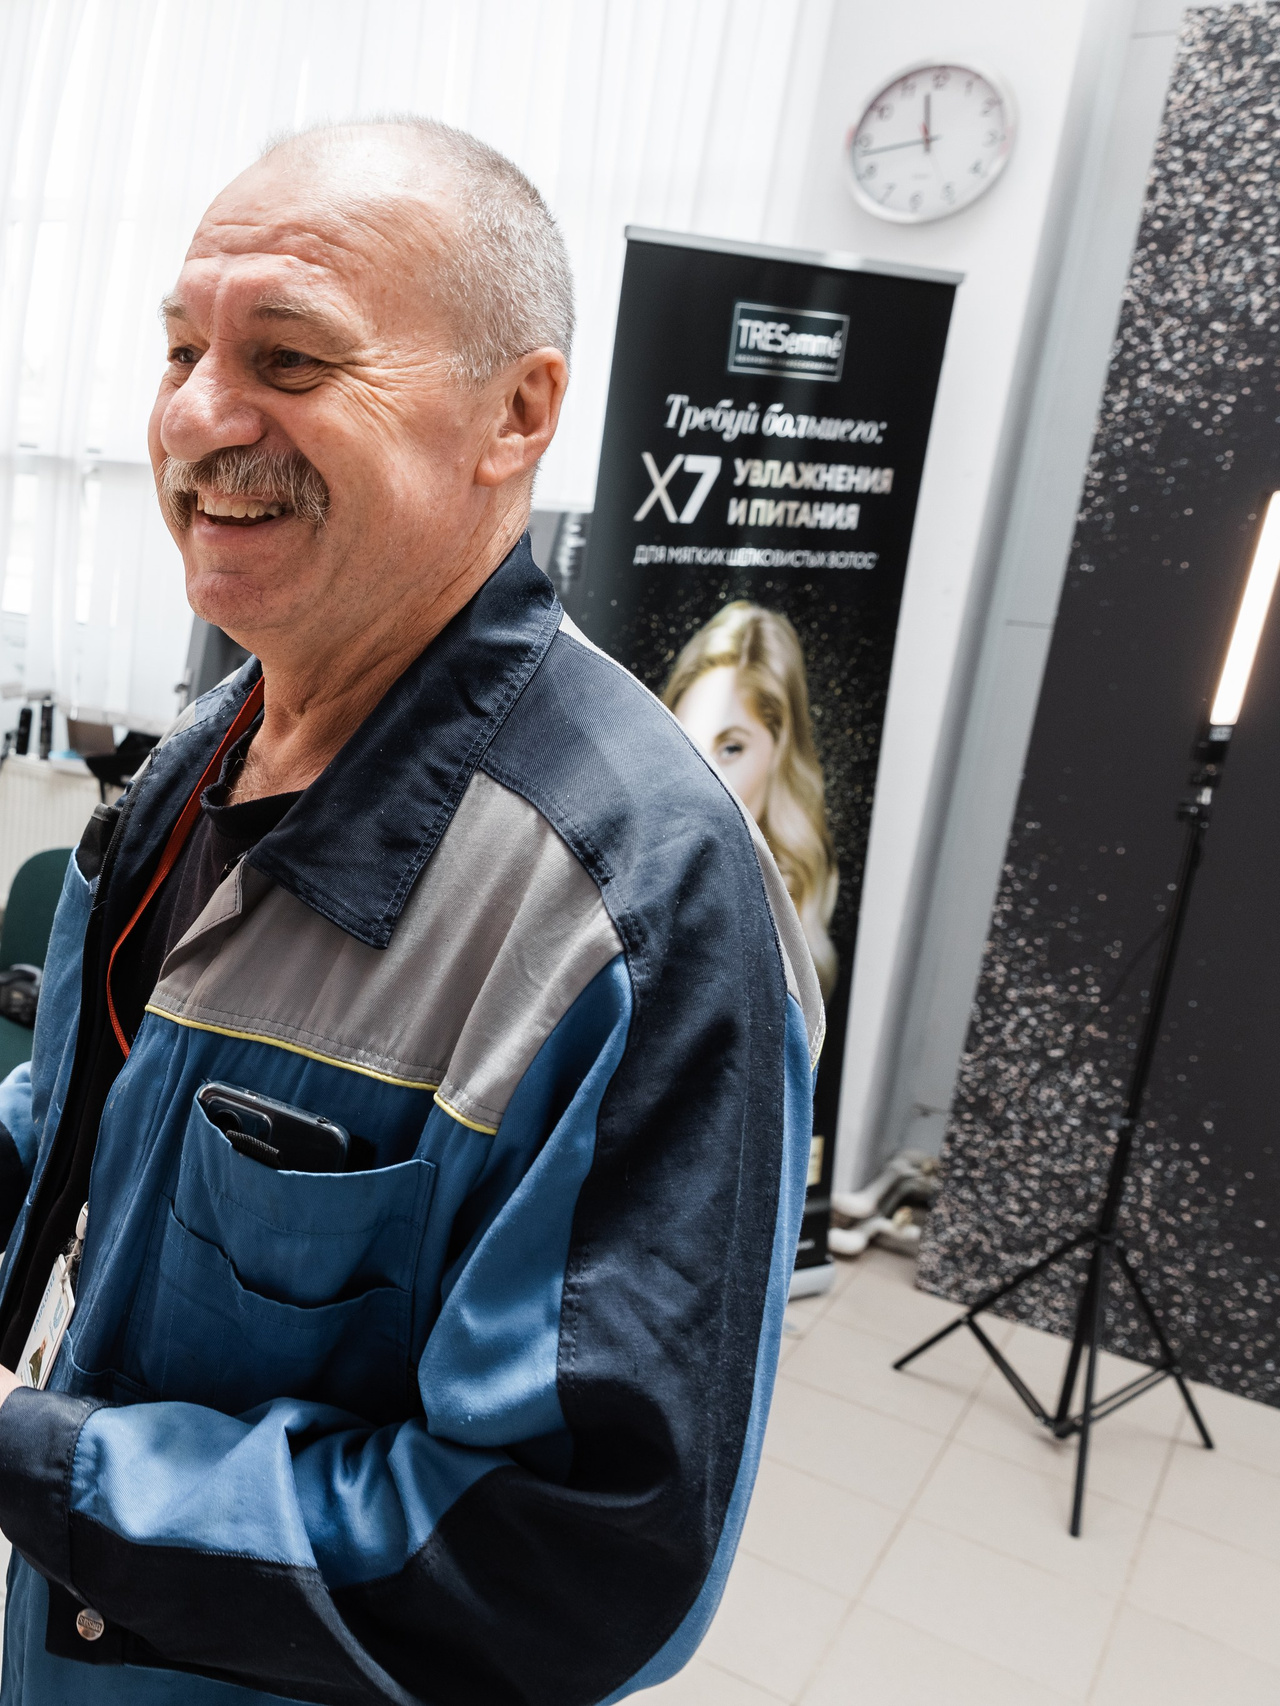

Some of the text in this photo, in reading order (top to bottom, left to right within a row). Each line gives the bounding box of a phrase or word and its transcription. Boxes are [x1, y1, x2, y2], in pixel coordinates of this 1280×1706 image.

[738, 318, 842, 359] TRESemmé
[664, 394, 761, 442] Требуй
[733, 457, 895, 494] УВЛАЖНЕНИЯ
[727, 498, 861, 530] И ПИТАНИЯ
[632, 544, 667, 566] ДЛЯ
[668, 546, 725, 566] МЯГКИХ
[826, 551, 880, 570] ВОЛОС
